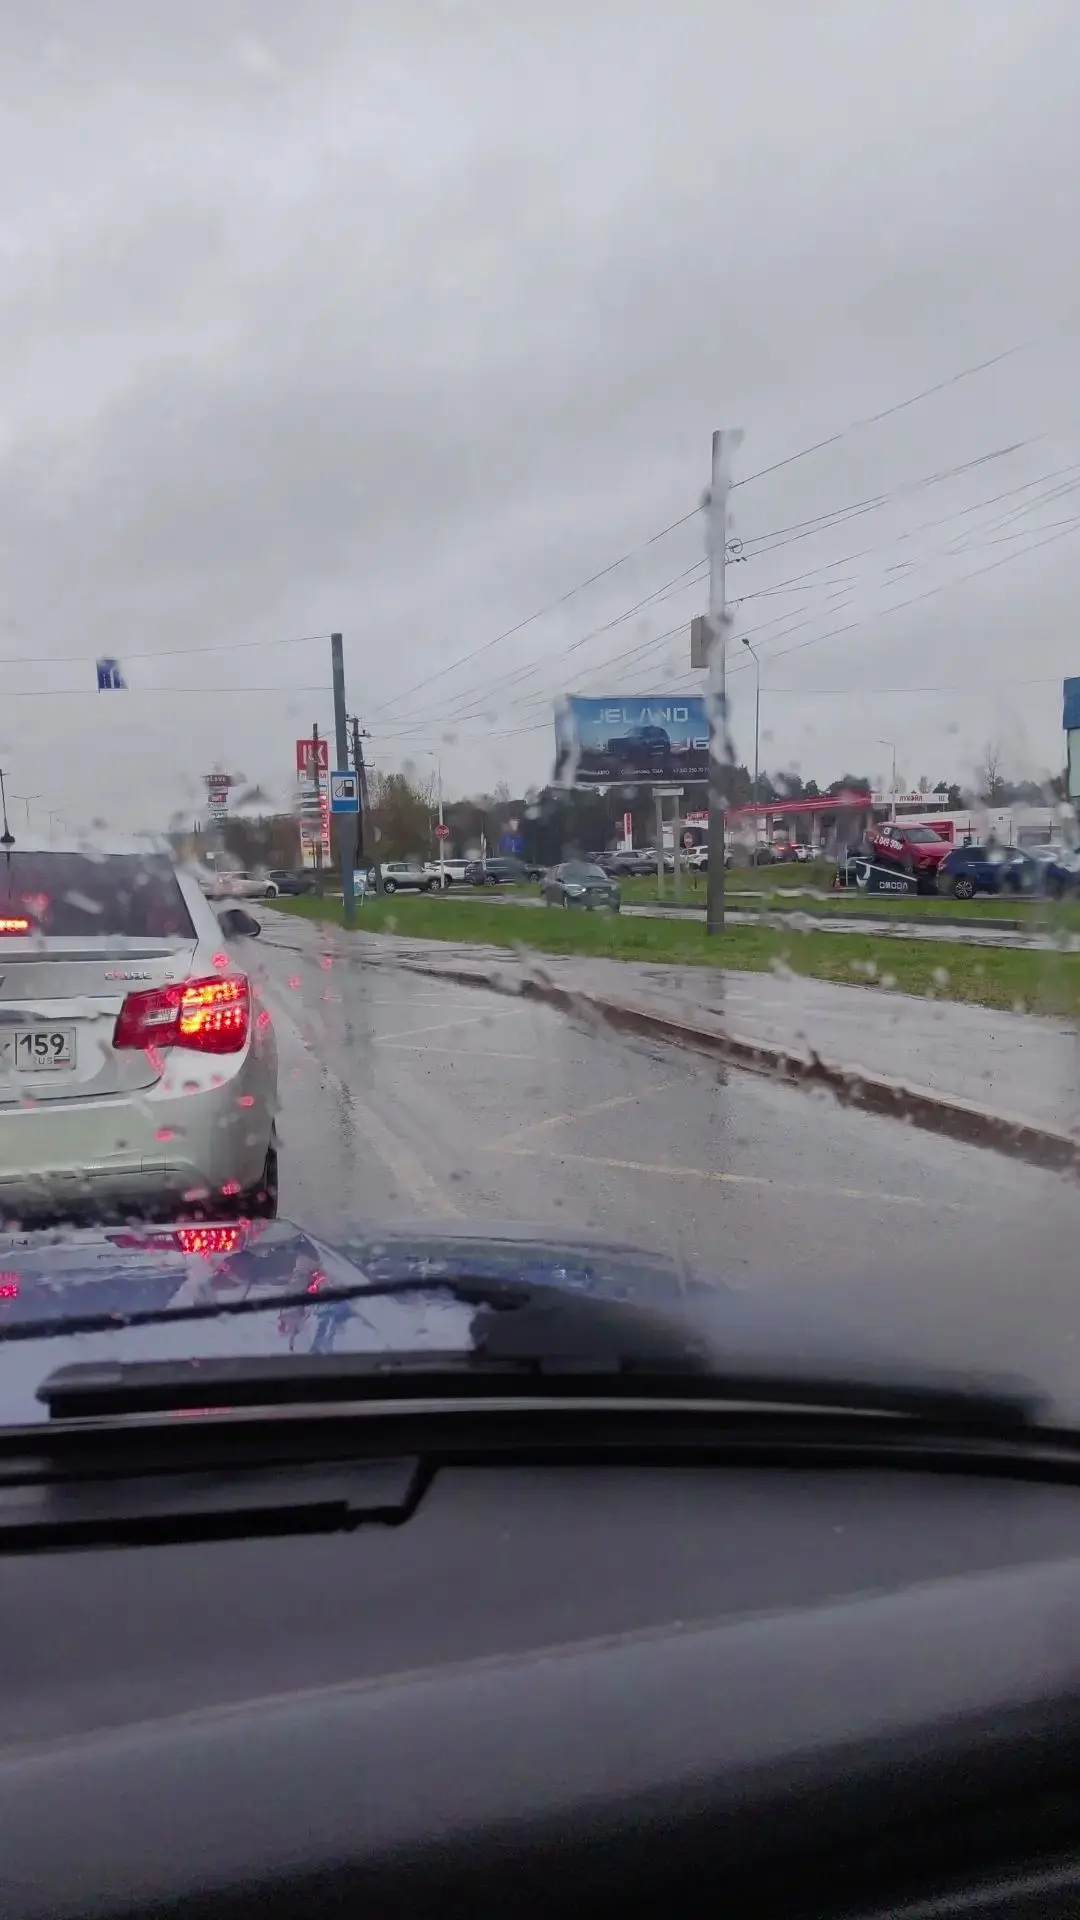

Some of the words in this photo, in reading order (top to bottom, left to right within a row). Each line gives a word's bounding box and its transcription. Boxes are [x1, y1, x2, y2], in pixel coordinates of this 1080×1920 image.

[592, 707, 689, 724] JELAND
[879, 881, 909, 890] OMODA
[19, 1033, 65, 1056] 159
